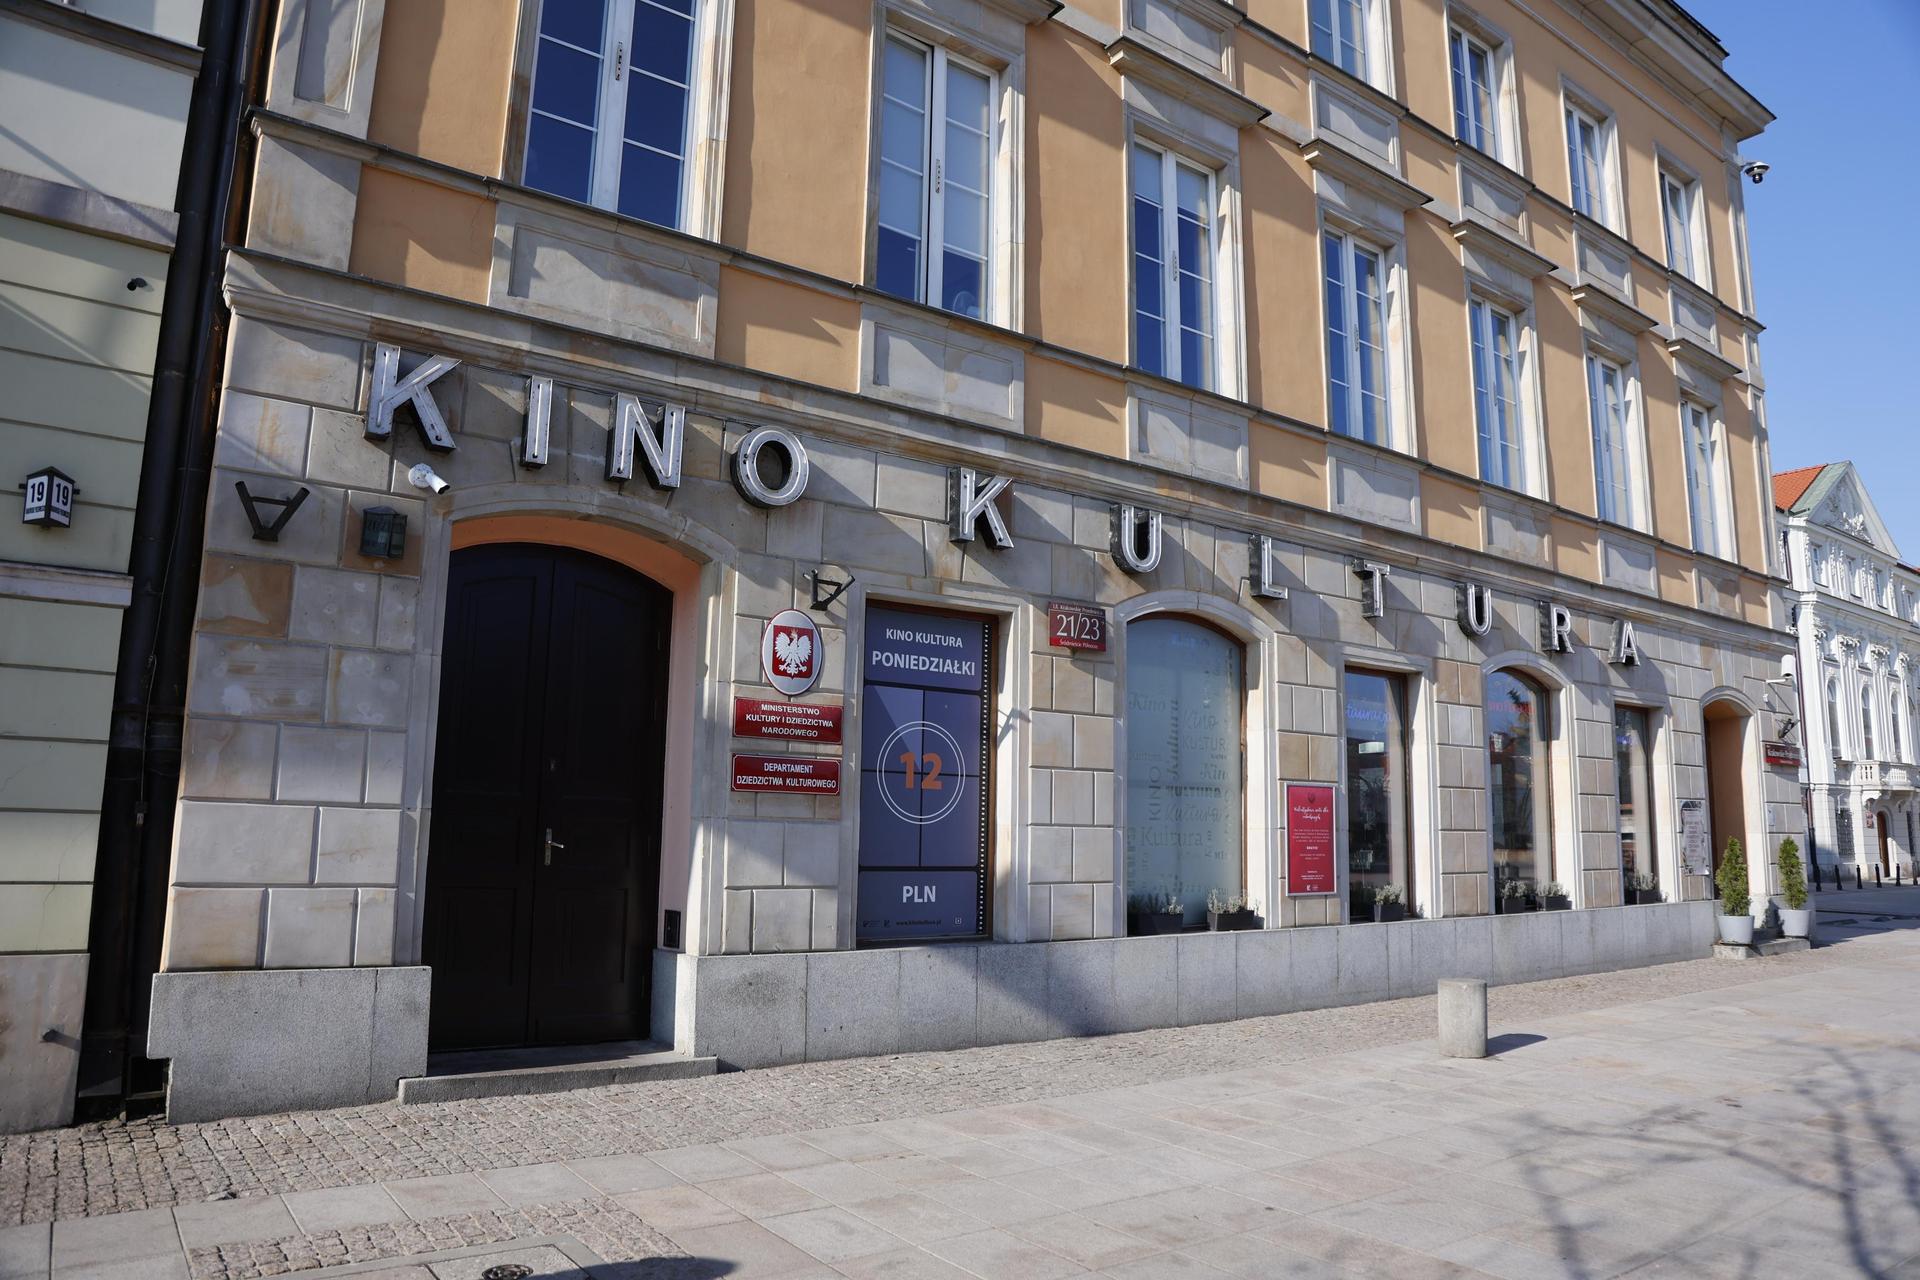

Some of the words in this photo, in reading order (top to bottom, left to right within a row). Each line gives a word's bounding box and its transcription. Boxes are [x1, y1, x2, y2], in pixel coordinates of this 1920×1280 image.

[30, 481, 45, 503] 19
[55, 482, 70, 507] 19
[363, 341, 810, 509] KINO
[950, 465, 1641, 667] KULTURA
[1056, 613, 1100, 641] 21/23
[886, 628, 914, 642] KINO
[915, 631, 963, 649] KULTURA
[872, 650, 976, 676] PONIEDZIAŁKI
[761, 703, 820, 716] MINISTERSTWO
[745, 713, 781, 723] KULTURY
[786, 716, 834, 728] DZIEDZICTWA
[761, 726, 818, 738] NARODOWEGO
[763, 762, 814, 774] DEPARTAMENT
[899, 751, 944, 791] 12
[736, 775, 784, 786] DZIEDZICTWA
[785, 777, 837, 789] KULTUROWEGO
[902, 885, 937, 903] PLN
